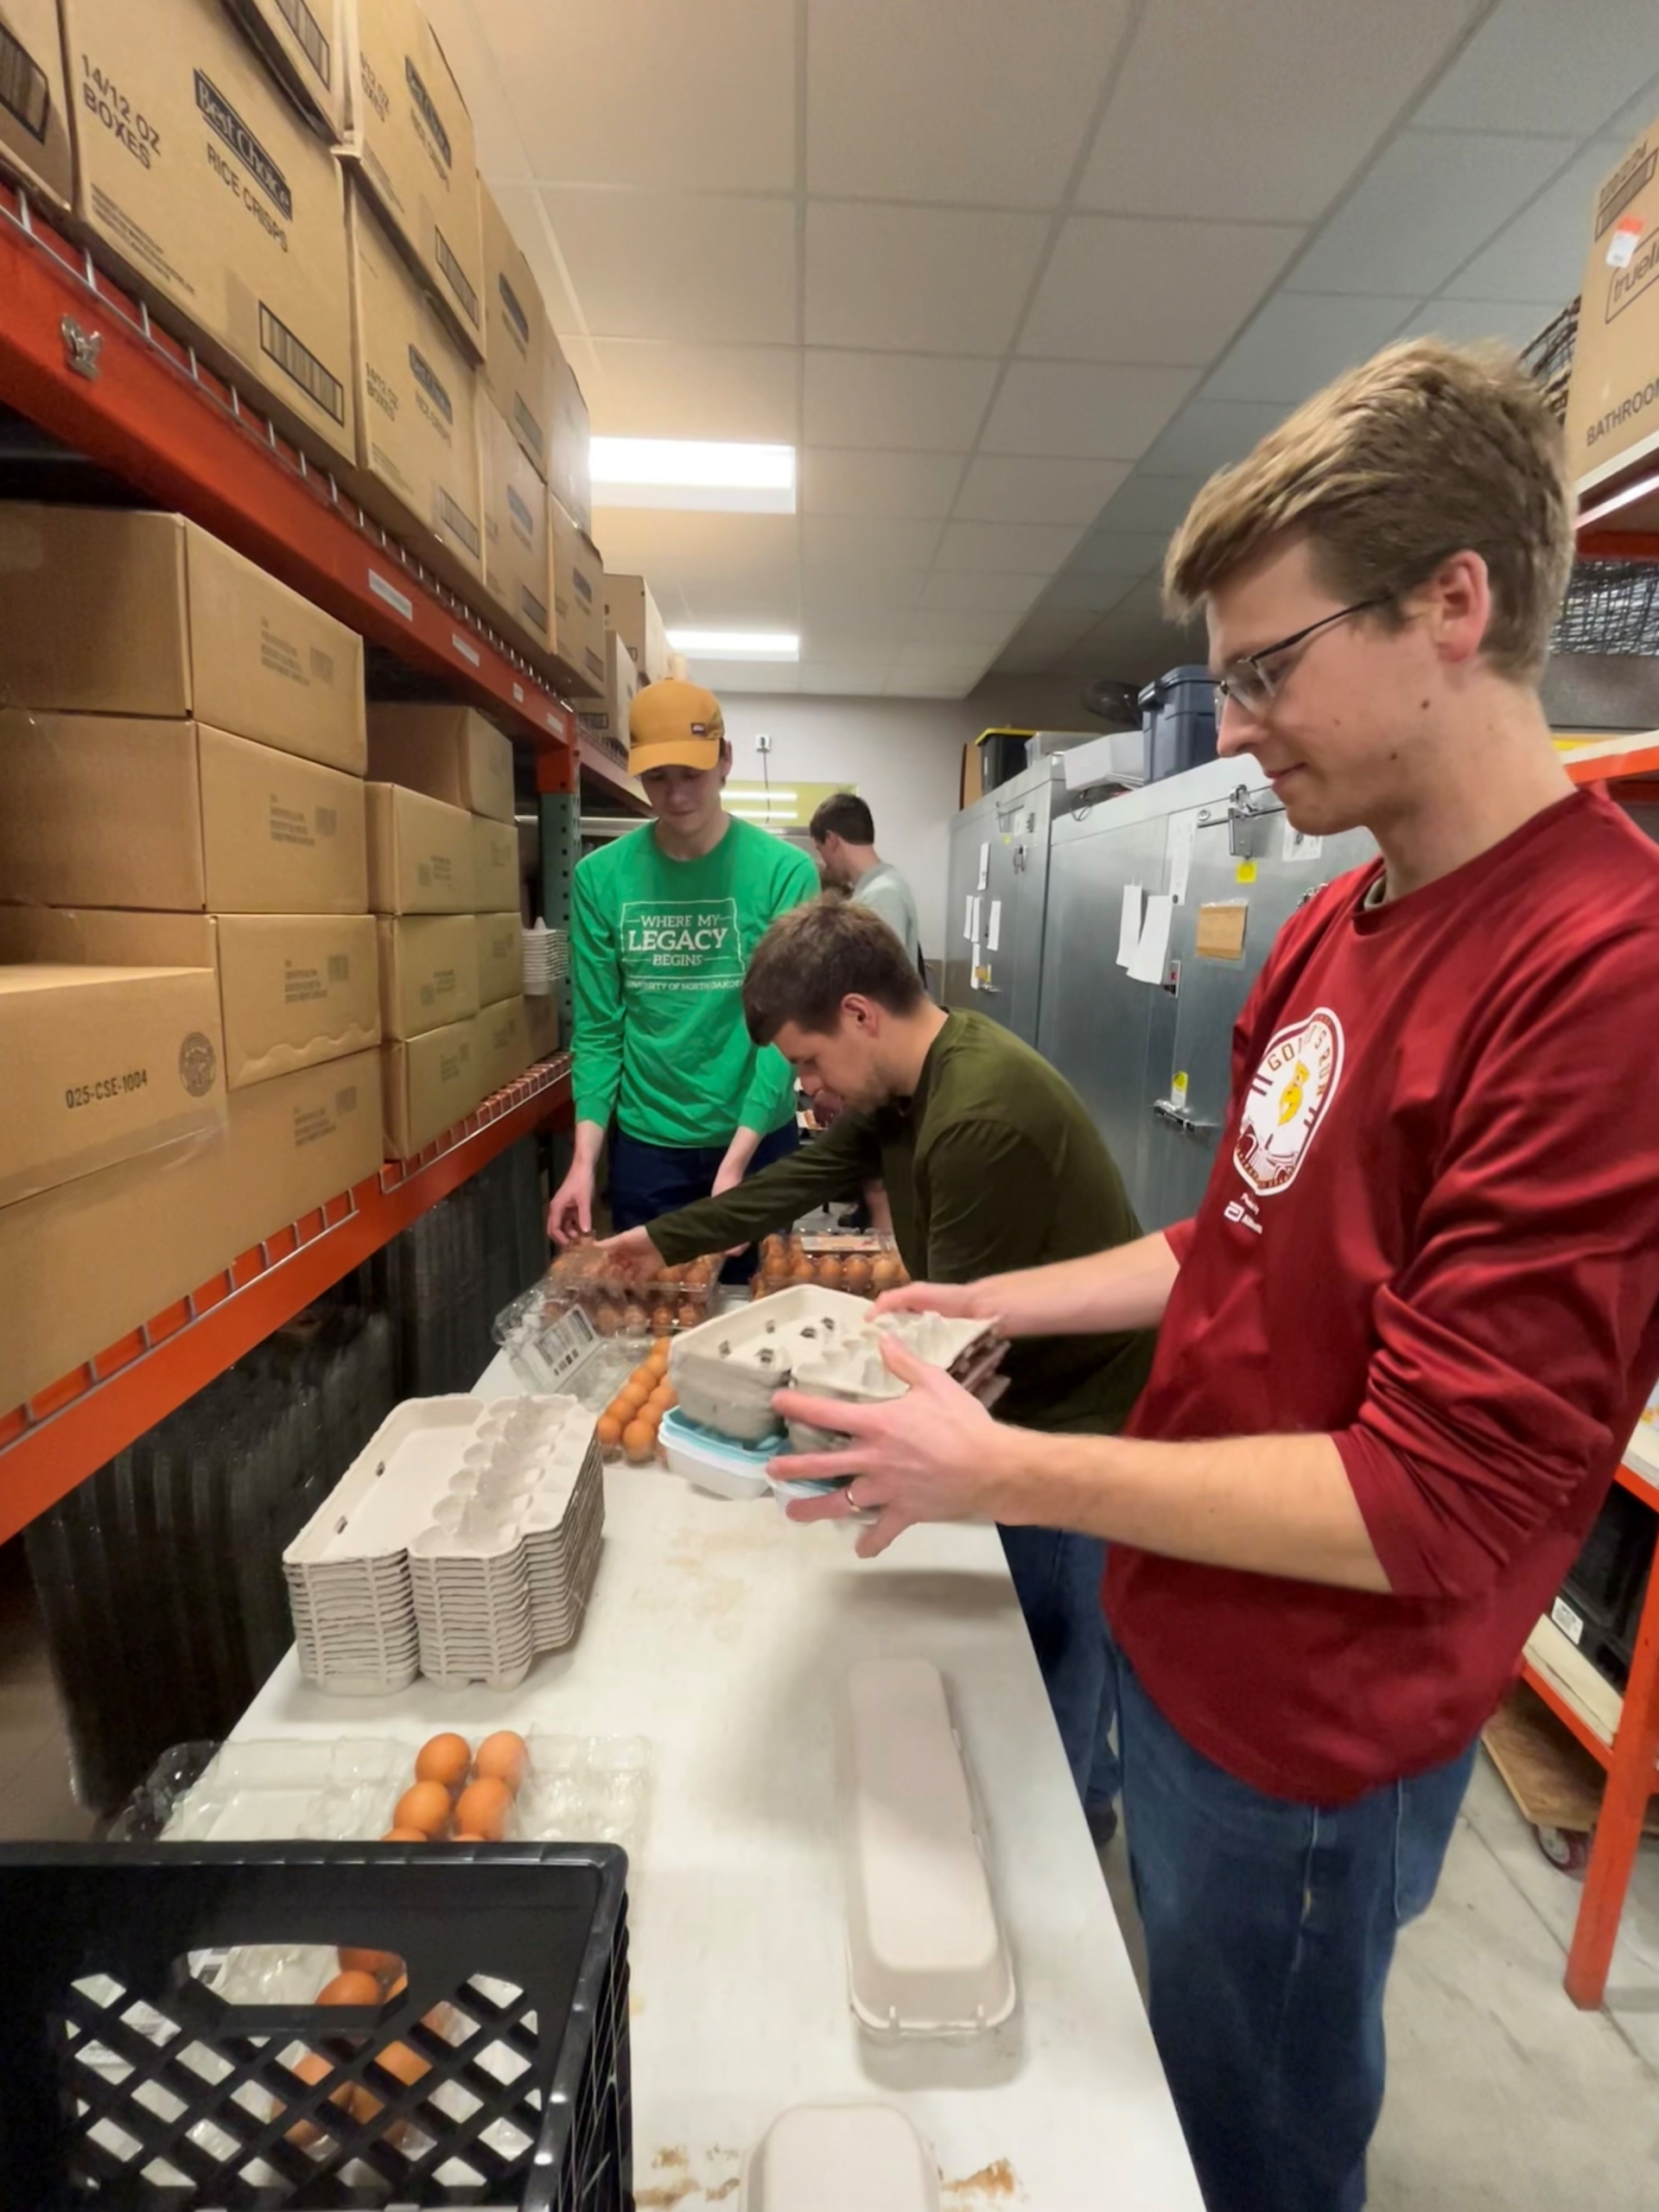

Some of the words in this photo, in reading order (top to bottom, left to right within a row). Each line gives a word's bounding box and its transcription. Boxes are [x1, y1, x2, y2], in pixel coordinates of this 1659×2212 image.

[81, 53, 130, 124] 14/12
[136, 112, 162, 157] OZ
[83, 81, 150, 170] BOXES
[198, 79, 236, 144] Best
[237, 129, 290, 210] Choice
[207, 141, 241, 199] RICE
[243, 186, 289, 253] CRISPS
[628, 928, 728, 951] LEGACY
[641, 914, 693, 928] WHERE
[697, 913, 721, 926] MY
[652, 954, 703, 966] BEGINS
[681, 982, 709, 991] NORTH
[66, 1069, 149, 1109] 025-CSE-1004
